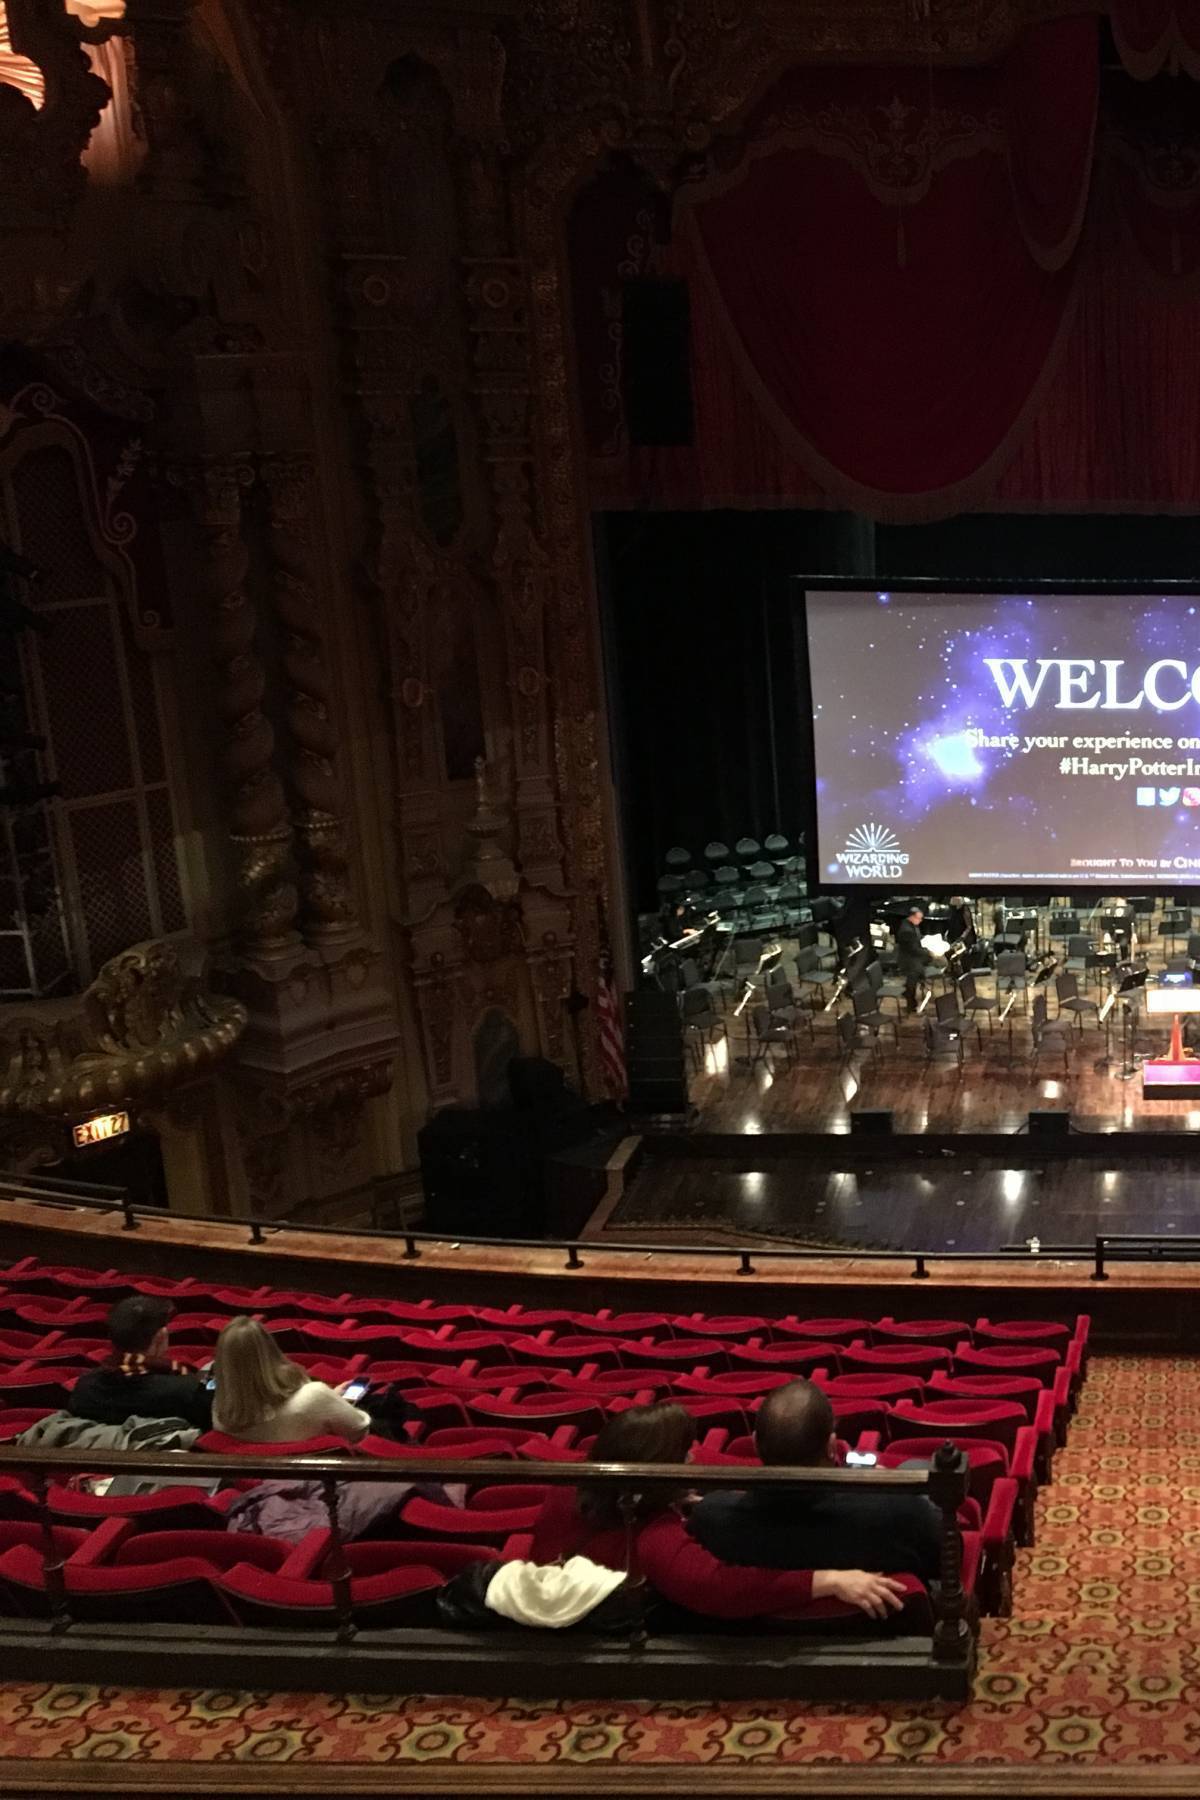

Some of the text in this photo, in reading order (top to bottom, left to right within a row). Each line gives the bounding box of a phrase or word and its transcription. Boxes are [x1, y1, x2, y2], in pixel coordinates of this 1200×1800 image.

[965, 729, 1020, 750] Share
[1024, 735, 1069, 754] your
[1072, 731, 1173, 754] experience
[1177, 736, 1200, 750] on
[835, 852, 910, 865] WIZARDING
[845, 864, 903, 879] WORLD
[74, 1114, 127, 1145] EXIT 27
